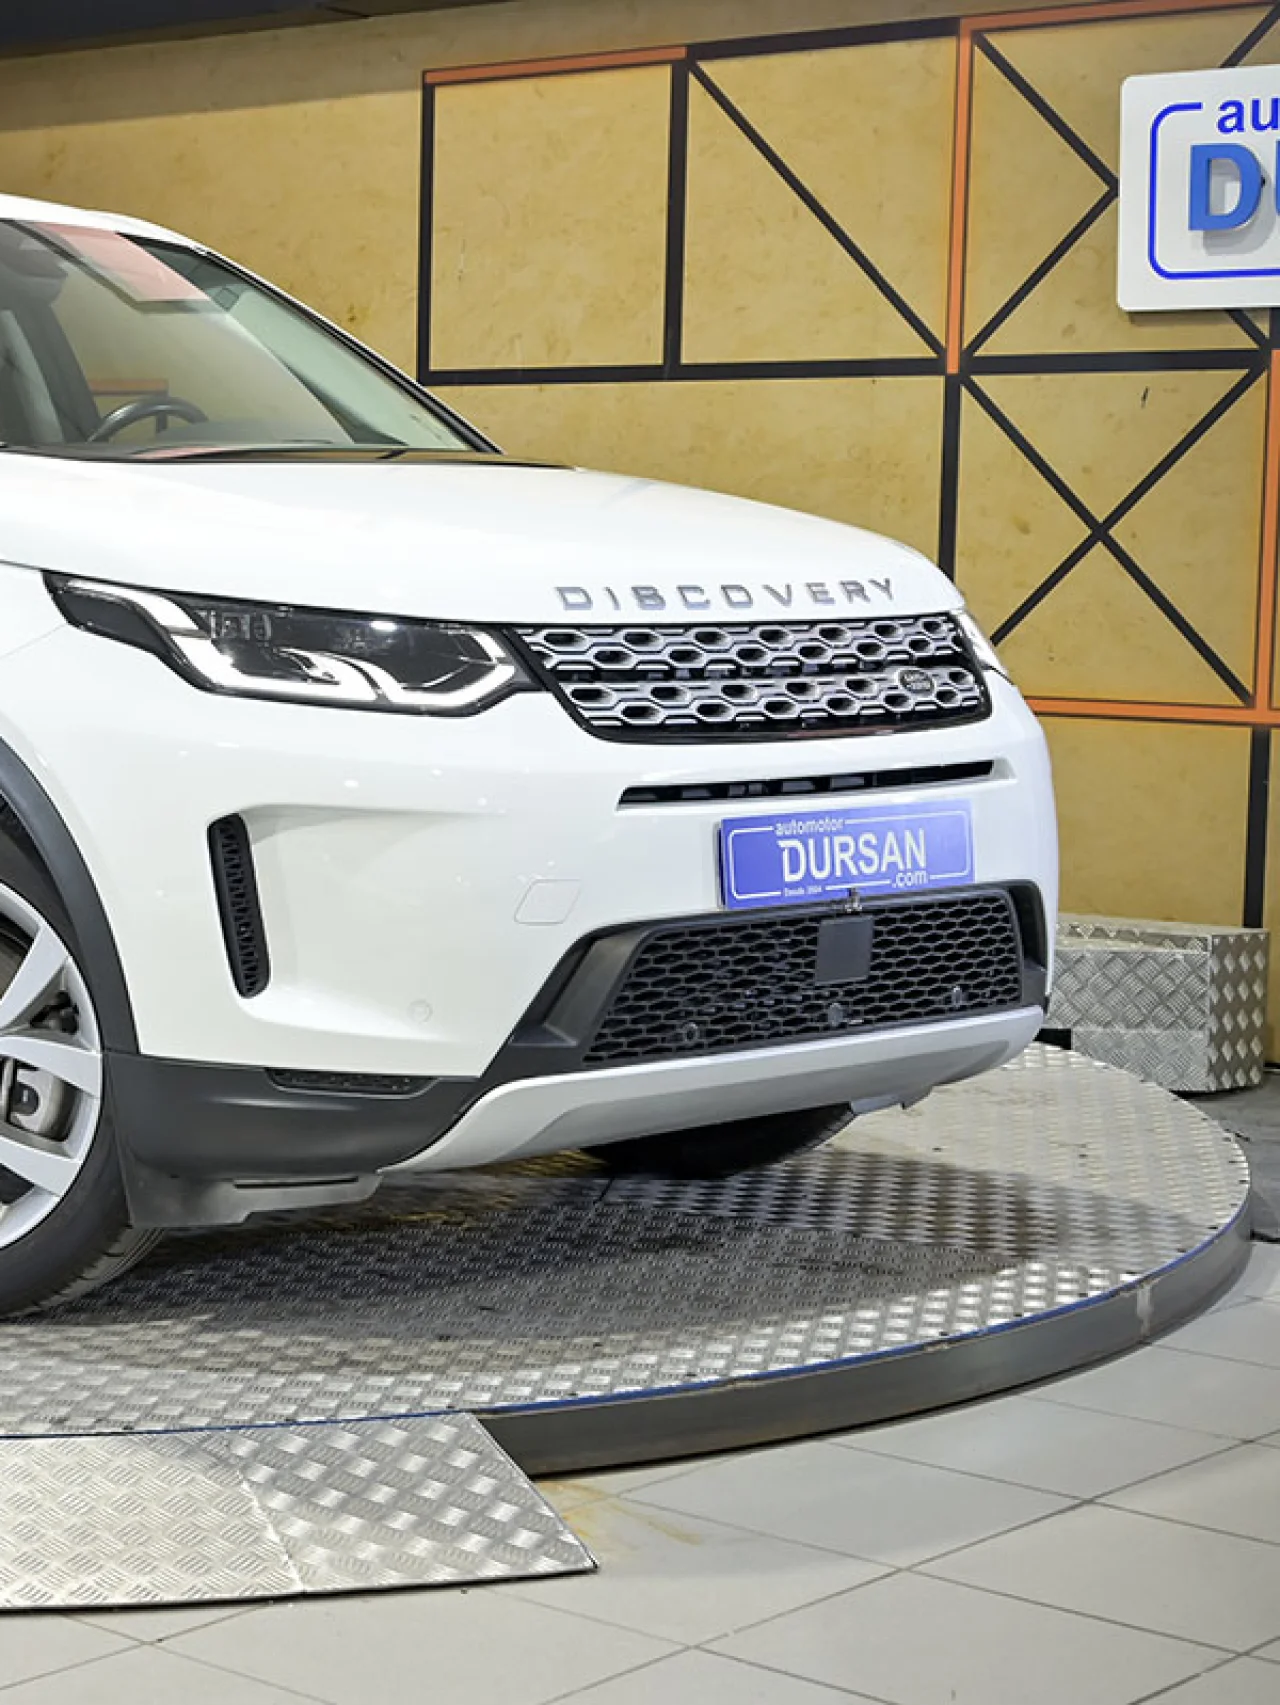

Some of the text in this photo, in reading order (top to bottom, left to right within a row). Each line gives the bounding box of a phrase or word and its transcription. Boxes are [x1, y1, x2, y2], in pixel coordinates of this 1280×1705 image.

[554, 578, 894, 611] DISCOVERY
[775, 817, 845, 836] automotor
[777, 828, 927, 882] DURSAN
